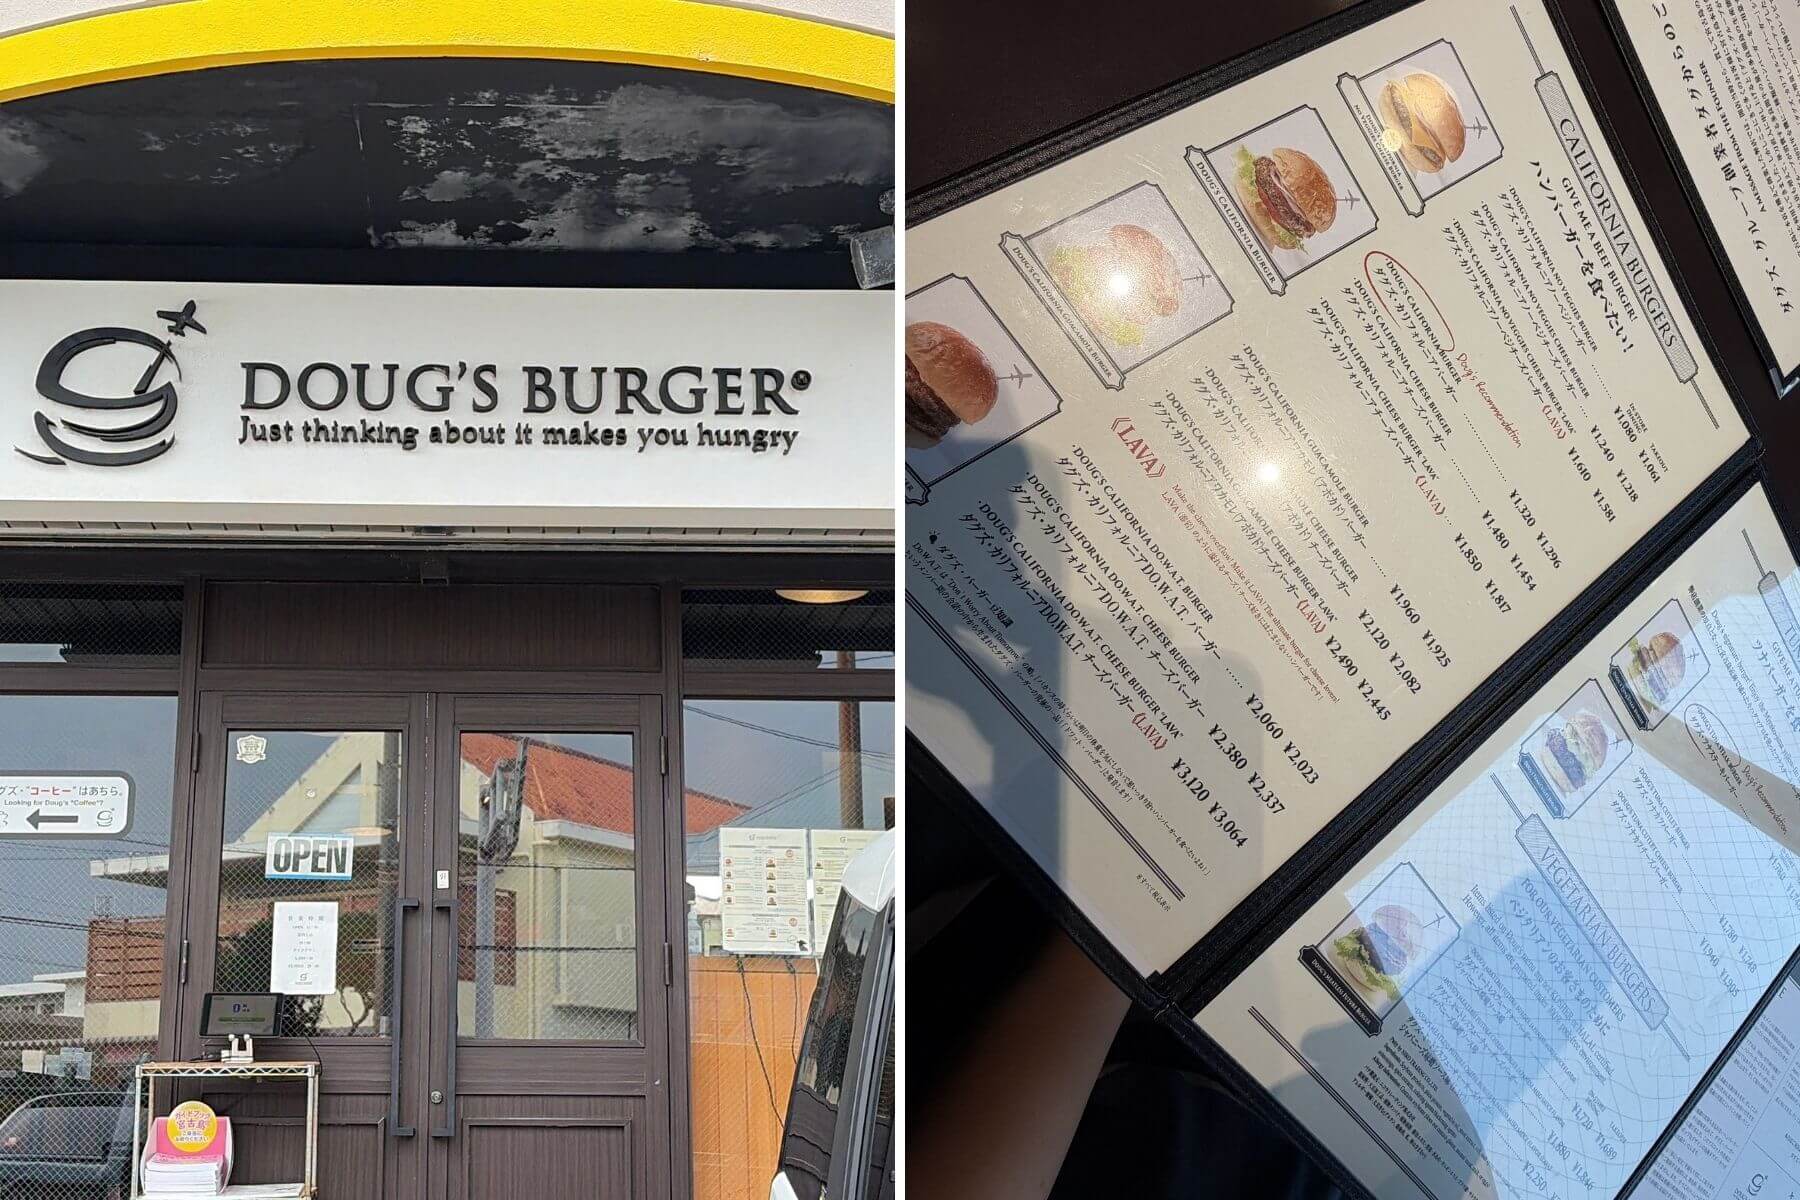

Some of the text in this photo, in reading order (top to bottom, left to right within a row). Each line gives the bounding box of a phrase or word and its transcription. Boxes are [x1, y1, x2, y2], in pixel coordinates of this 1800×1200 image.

[1718, 111, 1733, 134] THE
[1728, 134, 1745, 162] FROM
[1740, 162, 1763, 205] MESSAGE
[1507, 187, 1598, 352] DOUG'S CALIFORNIA NO VEGGIES BURGER
[1556, 115, 1678, 349] CALIFORNIA BURGERS
[1558, 175, 1639, 323] GIVE ME A BEEF BURGER!
[1384, 260, 1463, 385] DOUG'S CALIFORNIA BURGER
[1451, 220, 1563, 412] DOUG'S CALIFORNIA NO VEGGIES CHEESE BURGER
[1480, 203, 1590, 399] DOUG'S CALIFORNIA NO VEGGIES CHEESE BURGER
[240, 361, 499, 413] DOUG'S
[1319, 299, 1424, 457] DOUG'S CALIFORNIA CHEESE BURGER
[1352, 279, 1452, 436] DOUG'S CALIFORNIA CHEESE BURGER
[1452, 351, 1524, 449] Doug's Recommendation
[239, 415, 799, 455] Just thinking about it makes you hungry
[1242, 345, 1370, 528] DOUG'S CALIFORNIA GUACAMOLE BURGER
[1588, 424, 1639, 504] ¥1,240 ¥1,218
[1612, 405, 1660, 484] ¥1,080 ¥1,061
[1625, 408, 1642, 434] DINING
[1649, 442, 1668, 473] TAKEOUT
[1165, 391, 1320, 600] DOUG'S CALIFORNIA CHEESE BURGER
[1507, 488, 1562, 570] ¥1,320 ¥1,296
[1566, 446, 1616, 523] ¥1,610 ¥1,581
[1026, 473, 1201, 684] DOUG'S CALIFORNIA DO.W.A.T. CHEESE BURGER
[1072, 446, 1214, 623] DOUG'S CALIFORNIA DO.W.A.T. BURGER
[1452, 532, 1511, 616] ¥1,850 ¥1,817
[1480, 509, 1537, 593] ¥1,480 ¥1,454
[978, 502, 1162, 715] DOUG'S CALIFORNIA DO.W.A.T. CHEESE BURGER
[1355, 608, 1422, 696] ¥2,120 ¥2,082
[1387, 583, 1451, 669] ¥1,960 ¥1,925
[1322, 634, 1391, 723] ¥2,490 ¥2,445
[1204, 723, 1285, 818] ¥2,380 ¥2,337
[1242, 693, 1320, 786] ¥2,060 ¥2,023
[1167, 757, 1249, 849] ¥3,120 ¥3,064
[273, 838, 348, 874] OPEN
[1520, 877, 1626, 1023] FOR OUR VEGETARIAN CUSTOMERS
[1536, 844, 1613, 951] VEGETARIAN
[1605, 943, 1657, 1015] BURGERS
